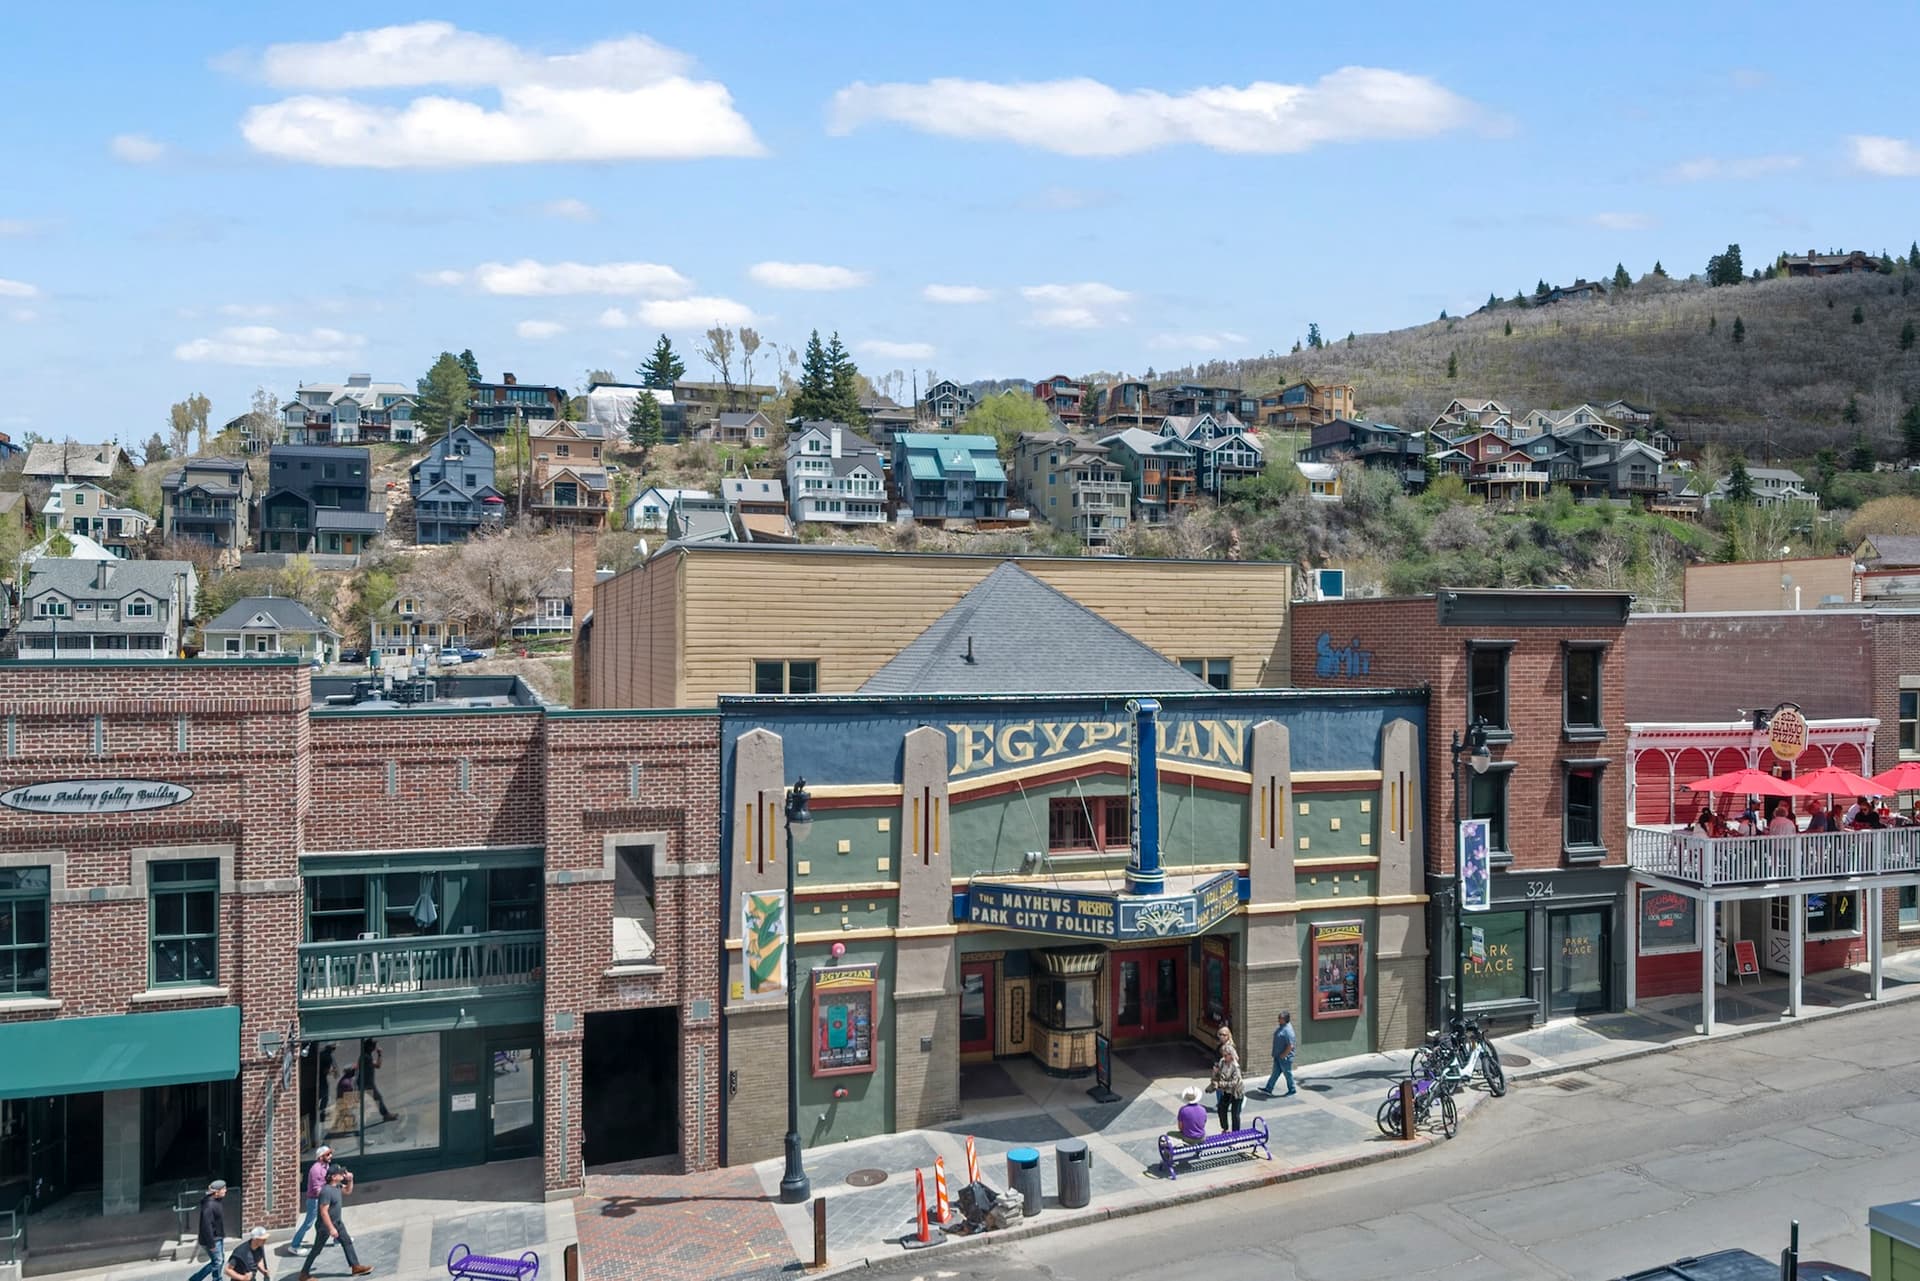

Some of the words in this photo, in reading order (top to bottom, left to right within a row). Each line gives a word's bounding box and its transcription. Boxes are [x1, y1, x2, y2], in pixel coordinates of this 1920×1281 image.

[1780, 711, 1797, 722] RED
[1772, 720, 1803, 735] BANJO
[1771, 731, 1802, 745] PIZZA
[12, 790, 52, 803] Thomas
[54, 788, 98, 803] Anthony
[100, 786, 134, 804] Gallery
[136, 786, 180, 802] Building
[1526, 881, 1554, 898] 324
[979, 893, 995, 905] THE
[1002, 892, 1071, 913] MAYHEWS
[1077, 899, 1114, 917] PRESENTS
[971, 906, 1008, 925] PARK
[1015, 911, 1048, 928] CITY
[1056, 915, 1115, 935] FOLLIES
[1565, 936, 1589, 946] PARK
[1562, 945, 1593, 956] PLACE
[1464, 958, 1514, 975] PLACE
[820, 969, 872, 982] EGYPTIAN
